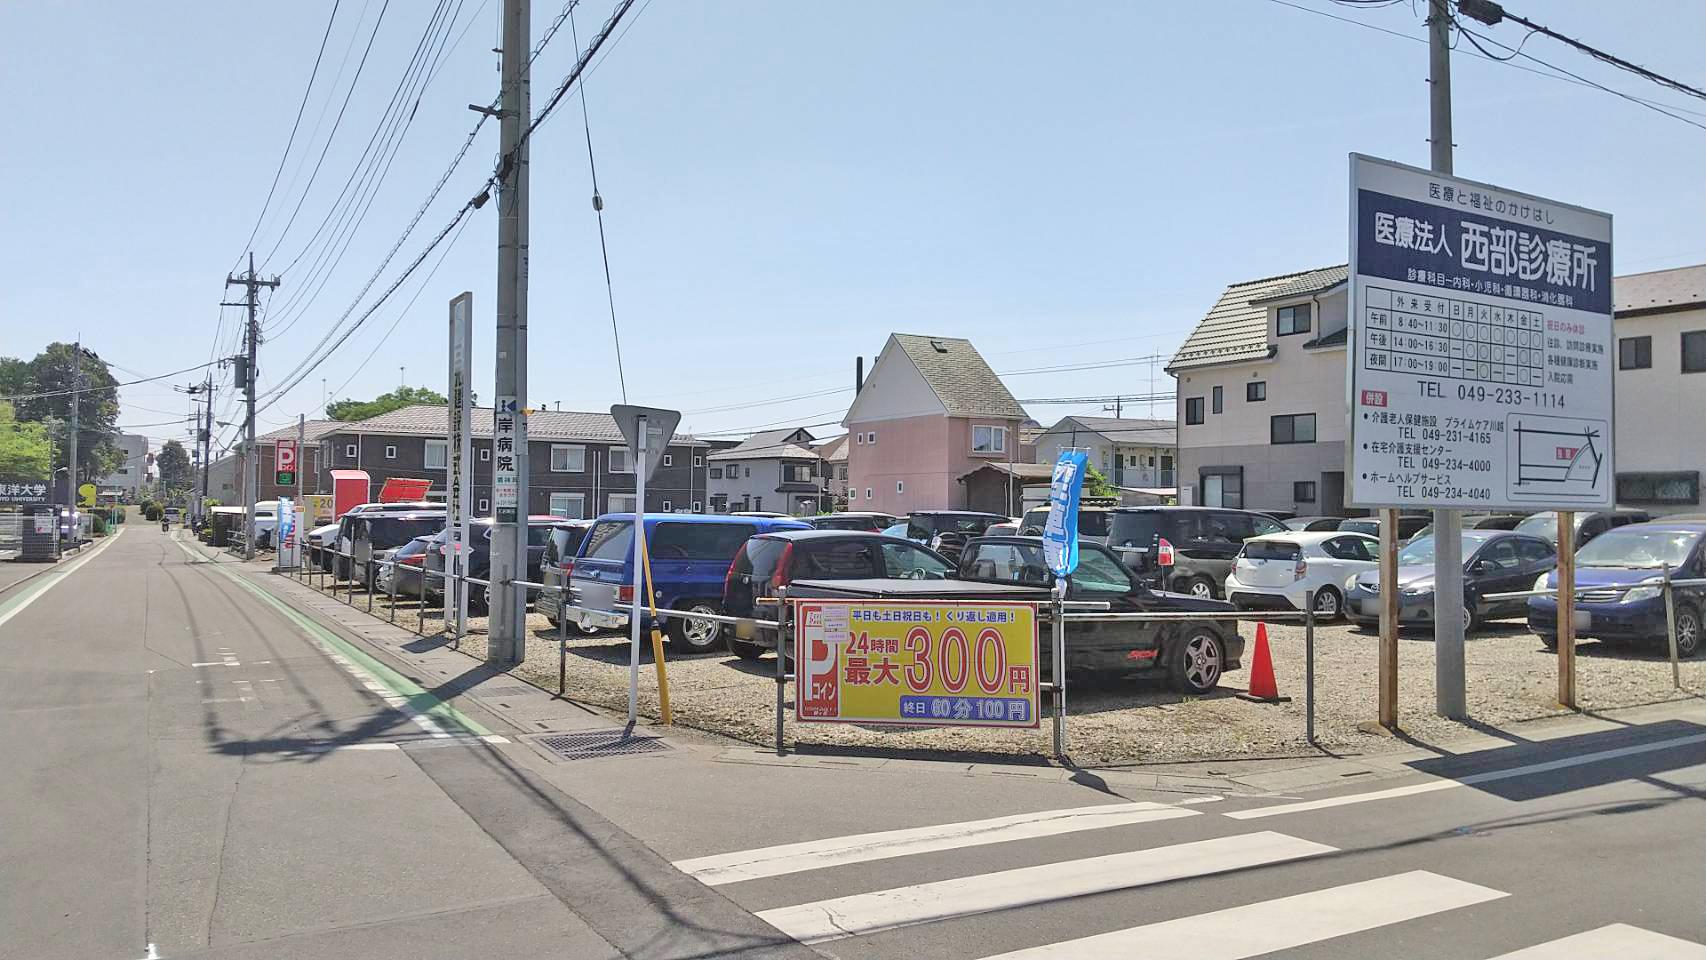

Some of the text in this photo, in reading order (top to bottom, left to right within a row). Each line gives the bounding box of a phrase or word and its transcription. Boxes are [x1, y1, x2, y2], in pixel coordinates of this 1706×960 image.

[1429, 182, 1555, 225] 医療と福祉のかけはし
[1374, 211, 1598, 293] 医療法人 西部診療所
[1370, 312, 1387, 326] 午前
[1397, 296, 1445, 315] 外来受付
[1453, 304, 1460, 316] 日
[1467, 306, 1473, 318] 月
[1480, 309, 1488, 320] 火
[1494, 311, 1501, 322] 水
[1520, 314, 1527, 326] 金
[1533, 316, 1540, 327] 土
[1370, 332, 1387, 346] 午後
[1370, 353, 1387, 367] 夜間
[1365, 392, 1384, 406] 併設
[1417, 381, 1565, 409] TEL 049-233-1114
[1371, 411, 1504, 433] 介護老人保健施設 プライムケア川越
[1398, 426, 1491, 444] TEL 049-231-4165
[497, 417, 514, 472] 岸病院
[1371, 441, 1452, 456] 在宅介護支援センター
[1397, 456, 1491, 472] TEL 049-234-4000
[1370, 471, 1452, 485] ホームヘルプサービス
[1397, 485, 1491, 500] TEL 049-234-4040
[852, 610, 1015, 623] 平日も土日祝日も！ くり返し適用！
[845, 631, 899, 655] 24時間
[805, 626, 836, 701] P
[844, 657, 900, 686] 最大
[812, 682, 835, 700] コイン
[903, 702, 926, 714] 終日
